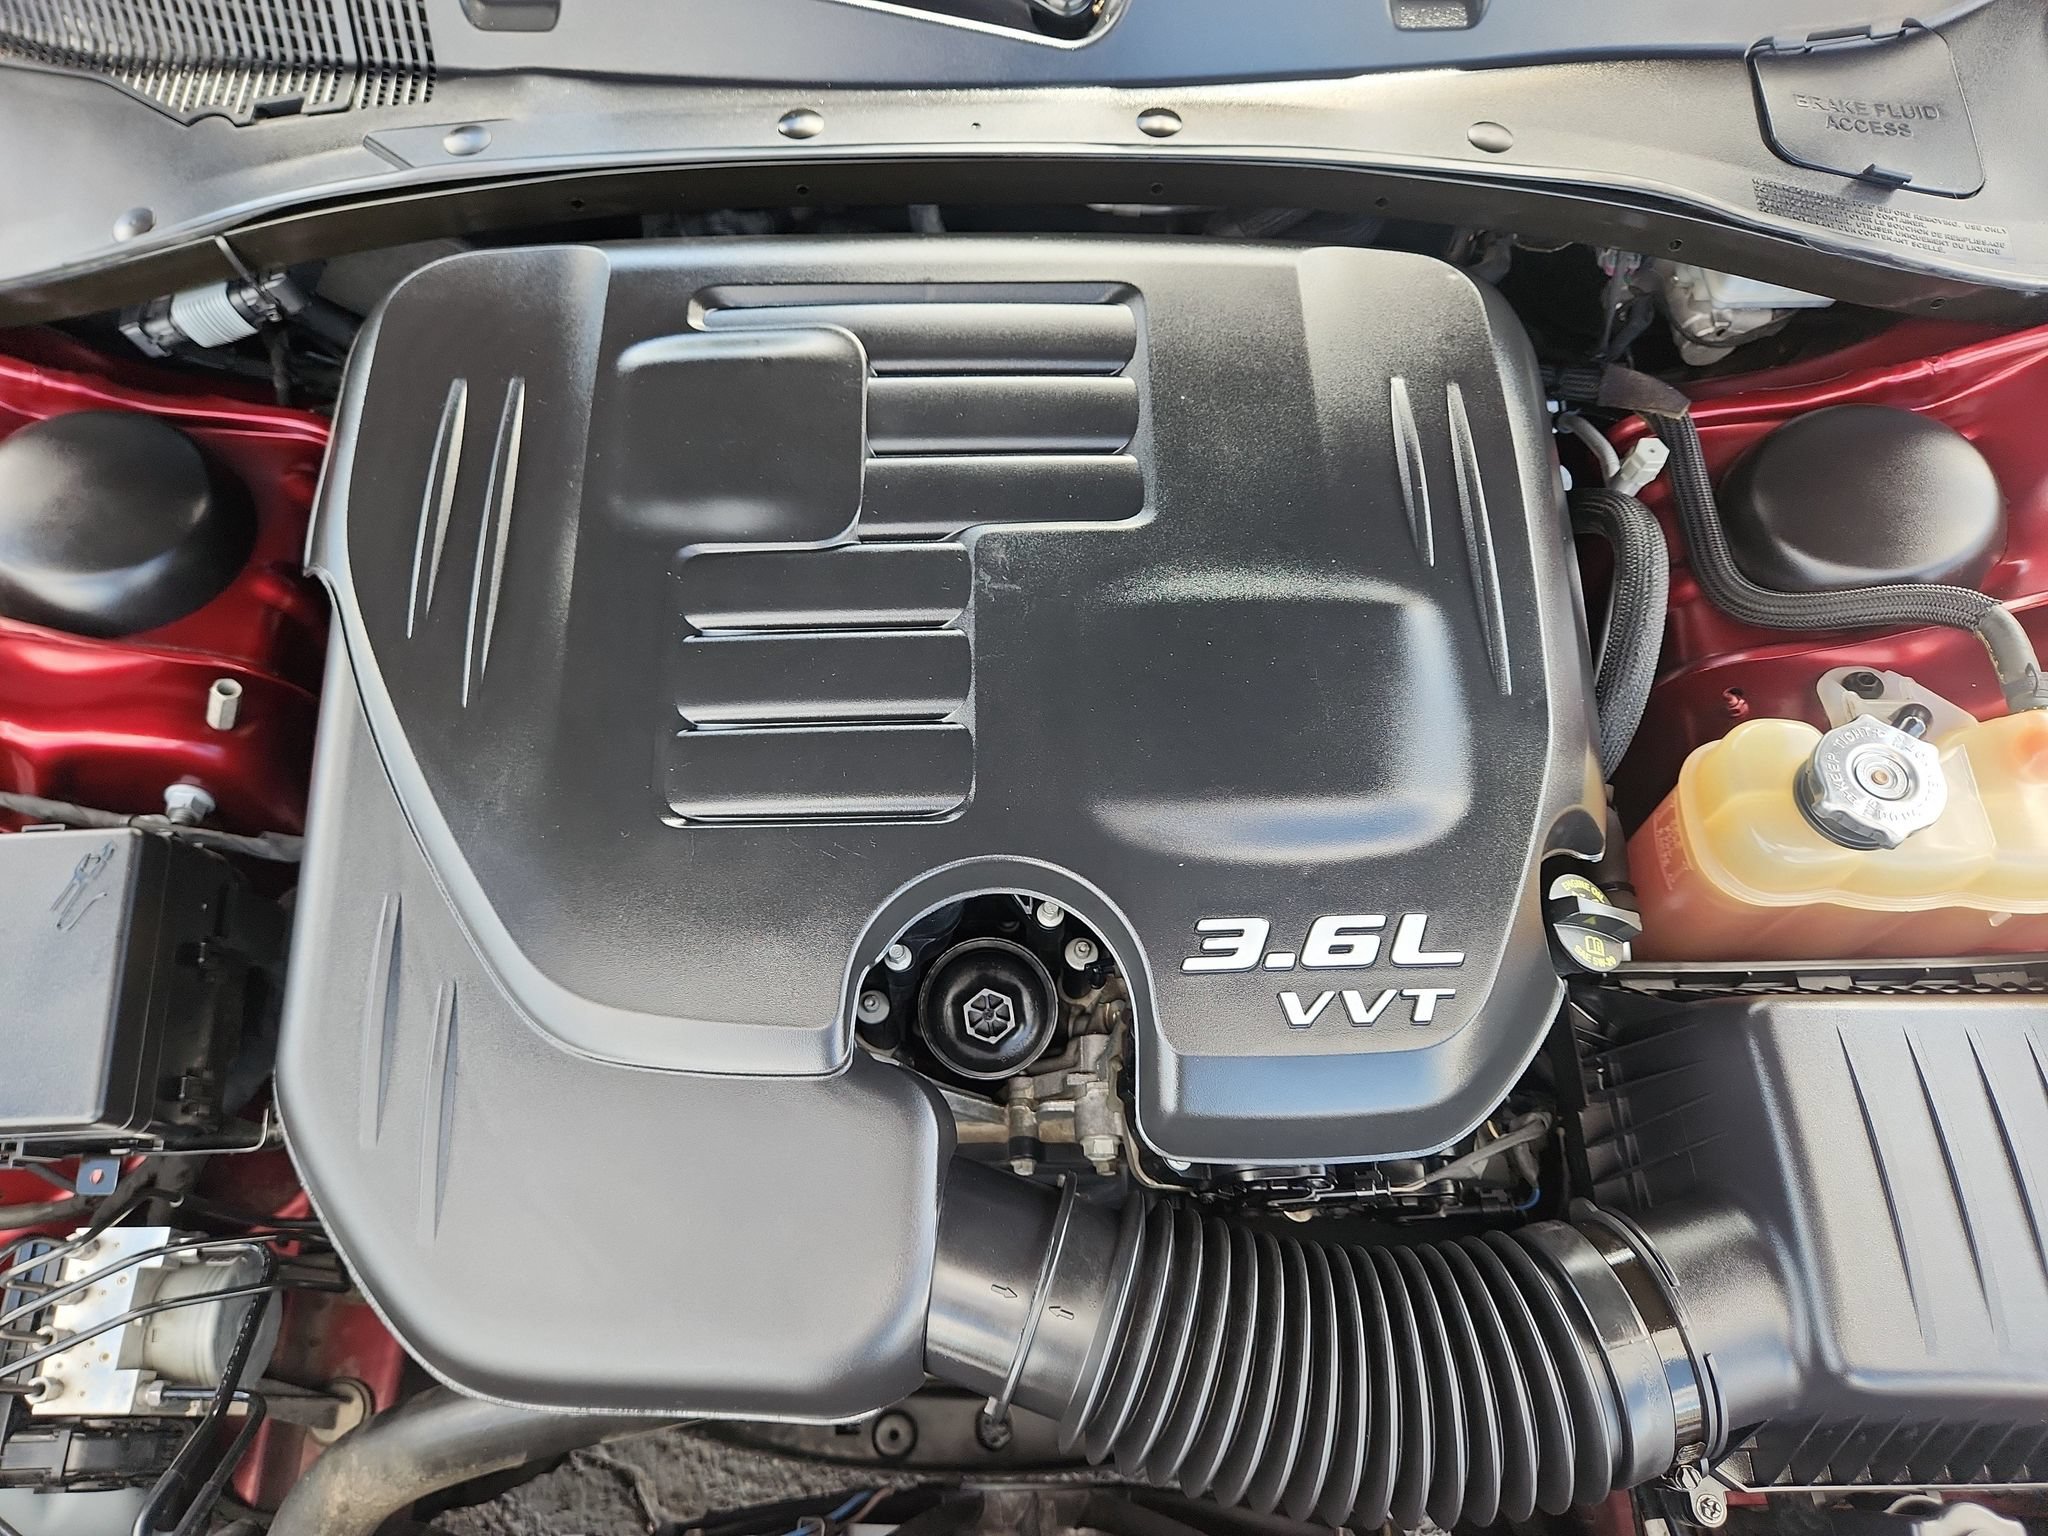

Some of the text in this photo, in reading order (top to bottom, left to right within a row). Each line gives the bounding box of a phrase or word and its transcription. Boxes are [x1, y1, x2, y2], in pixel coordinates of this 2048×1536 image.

[1793, 93, 1941, 121] BRAKE FLUID
[1826, 115, 1914, 138] ACCESS
[1984, 226, 2008, 235] ONLY
[1825, 727, 1871, 792] KEEP TIGHT
[1561, 879, 1591, 892] ENGINE
[1179, 912, 1466, 975] 3.6L
[1574, 944, 1592, 962] SAE
[1276, 988, 1457, 1029] VVT
